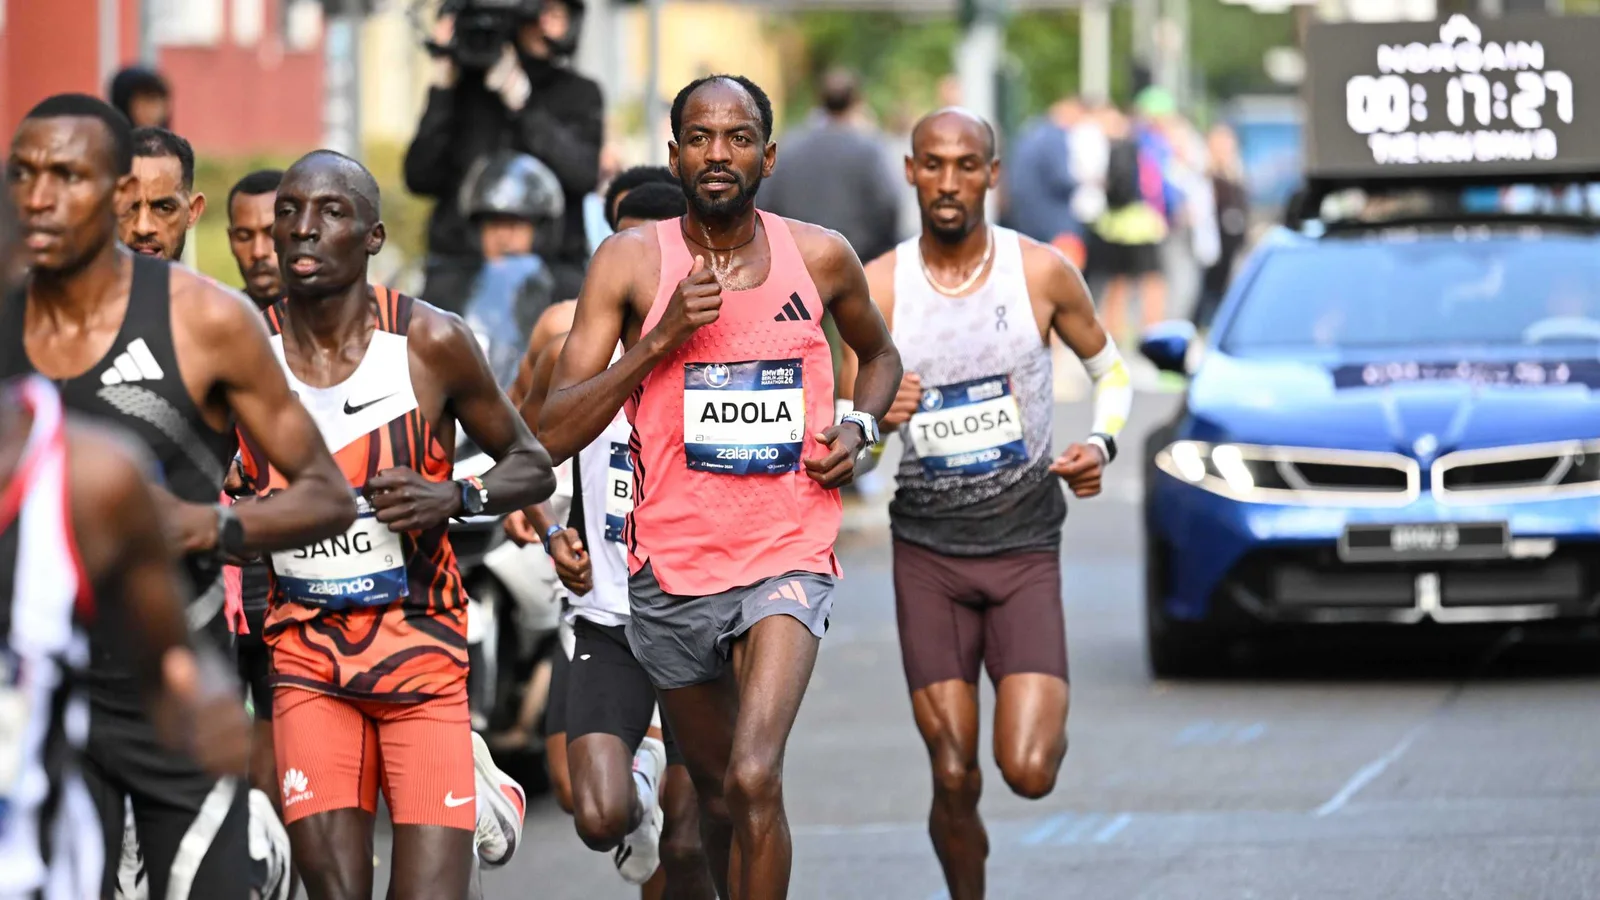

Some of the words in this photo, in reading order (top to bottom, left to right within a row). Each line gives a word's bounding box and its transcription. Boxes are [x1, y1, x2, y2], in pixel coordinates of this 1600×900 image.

[1377, 41, 1544, 73] NORQAIN
[784, 368, 794, 376] 20
[784, 376, 794, 385] 26
[700, 401, 792, 424] ADOLA
[917, 409, 1012, 441] TOLOSA
[790, 429, 798, 441] 6
[716, 446, 779, 460] zalando
[614, 479, 634, 500] B
[384, 555, 394, 567] 9
[307, 578, 375, 595] zalando
